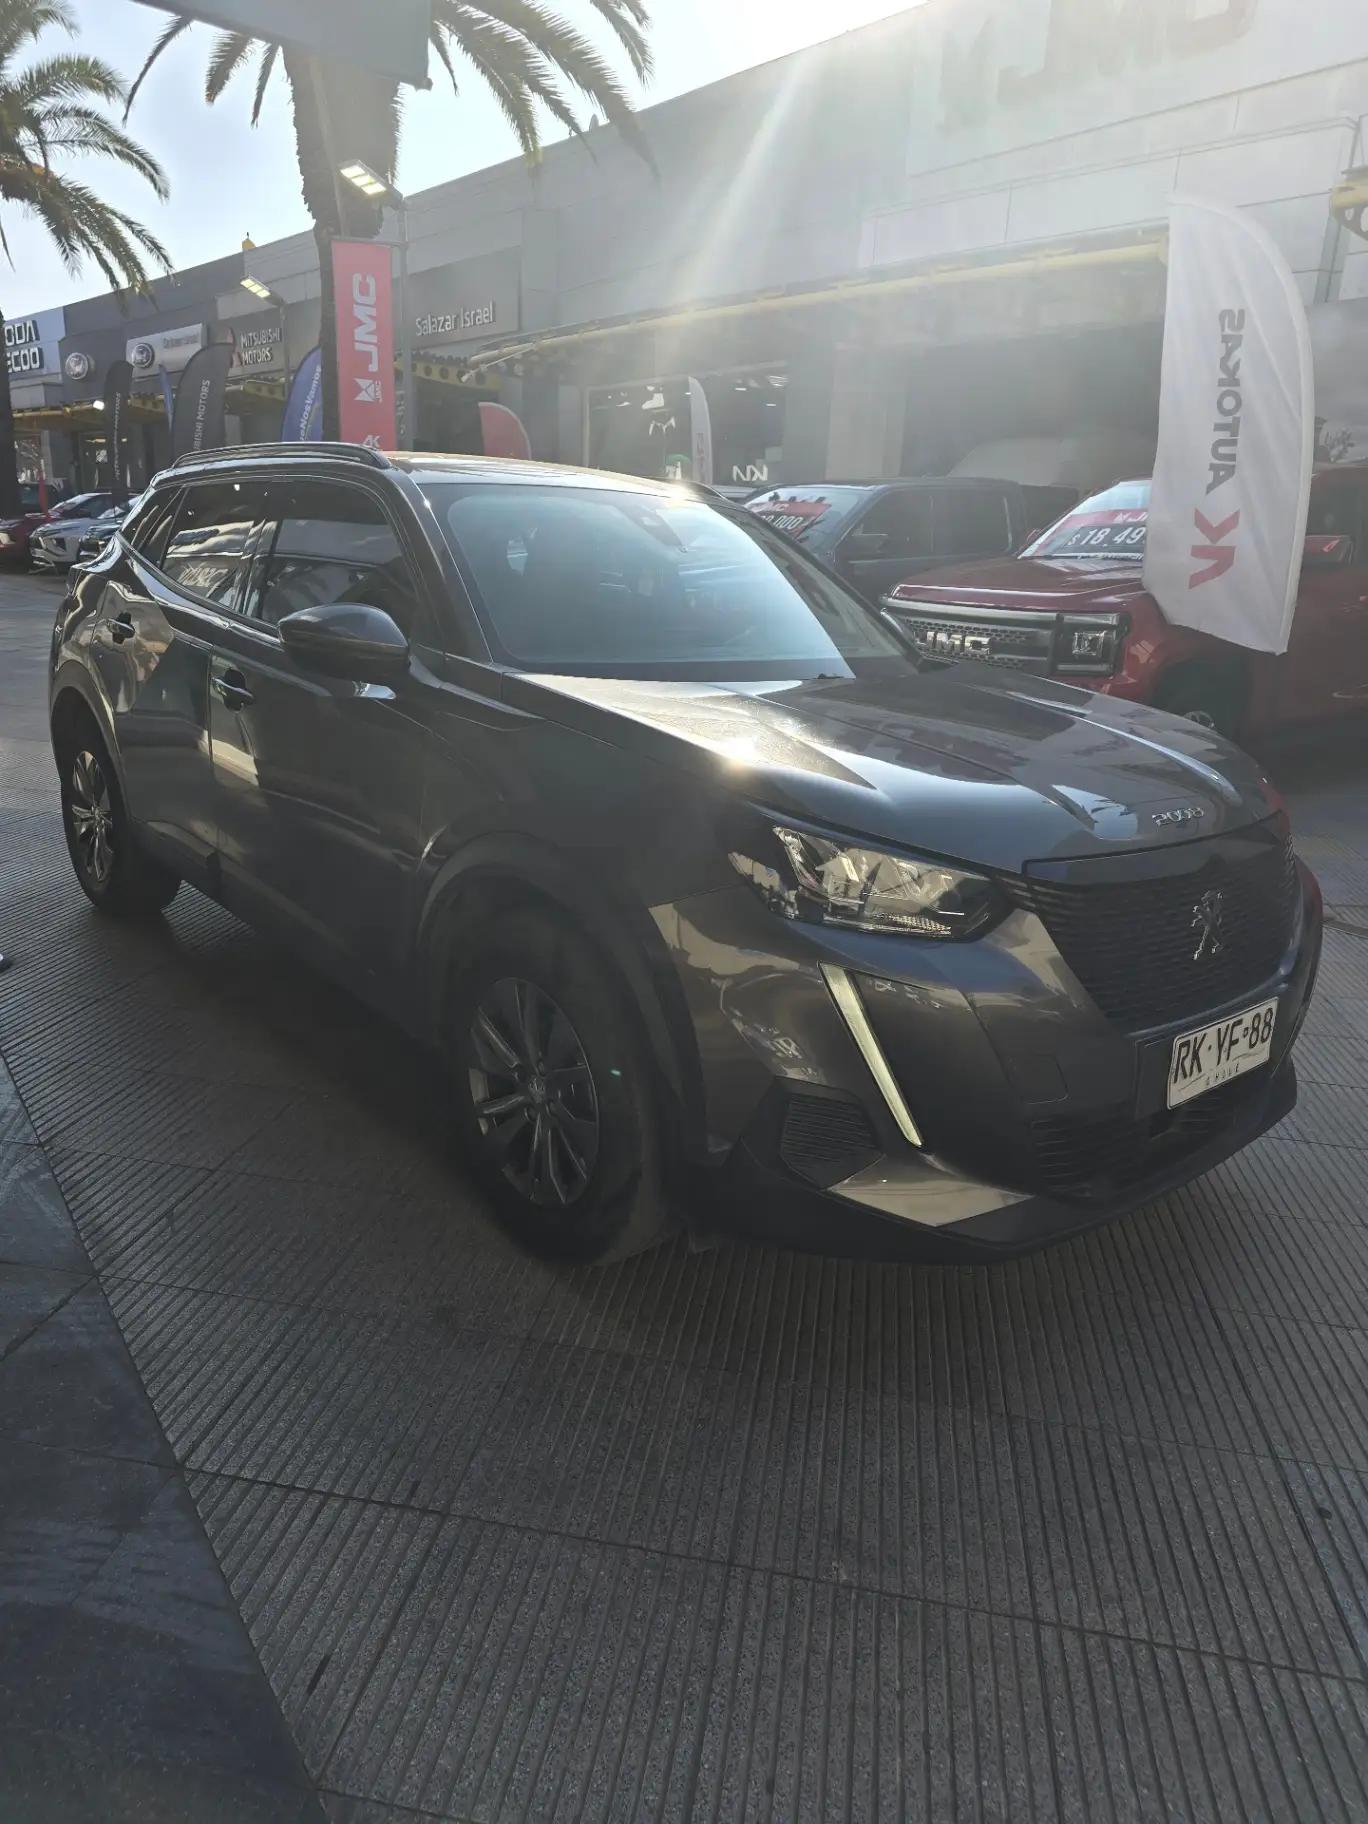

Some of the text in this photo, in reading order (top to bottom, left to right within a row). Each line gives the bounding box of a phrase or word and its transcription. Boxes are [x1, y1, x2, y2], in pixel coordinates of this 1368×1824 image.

[352, 273, 379, 372] JMC
[415, 300, 494, 336] Salazar Israel
[4, 320, 37, 346] ODA
[240, 327, 281, 347] MITSUBISHI
[240, 347, 273, 366] MOTORS
[196, 379, 211, 421] MOTORS
[914, 630, 991, 656] JMC
